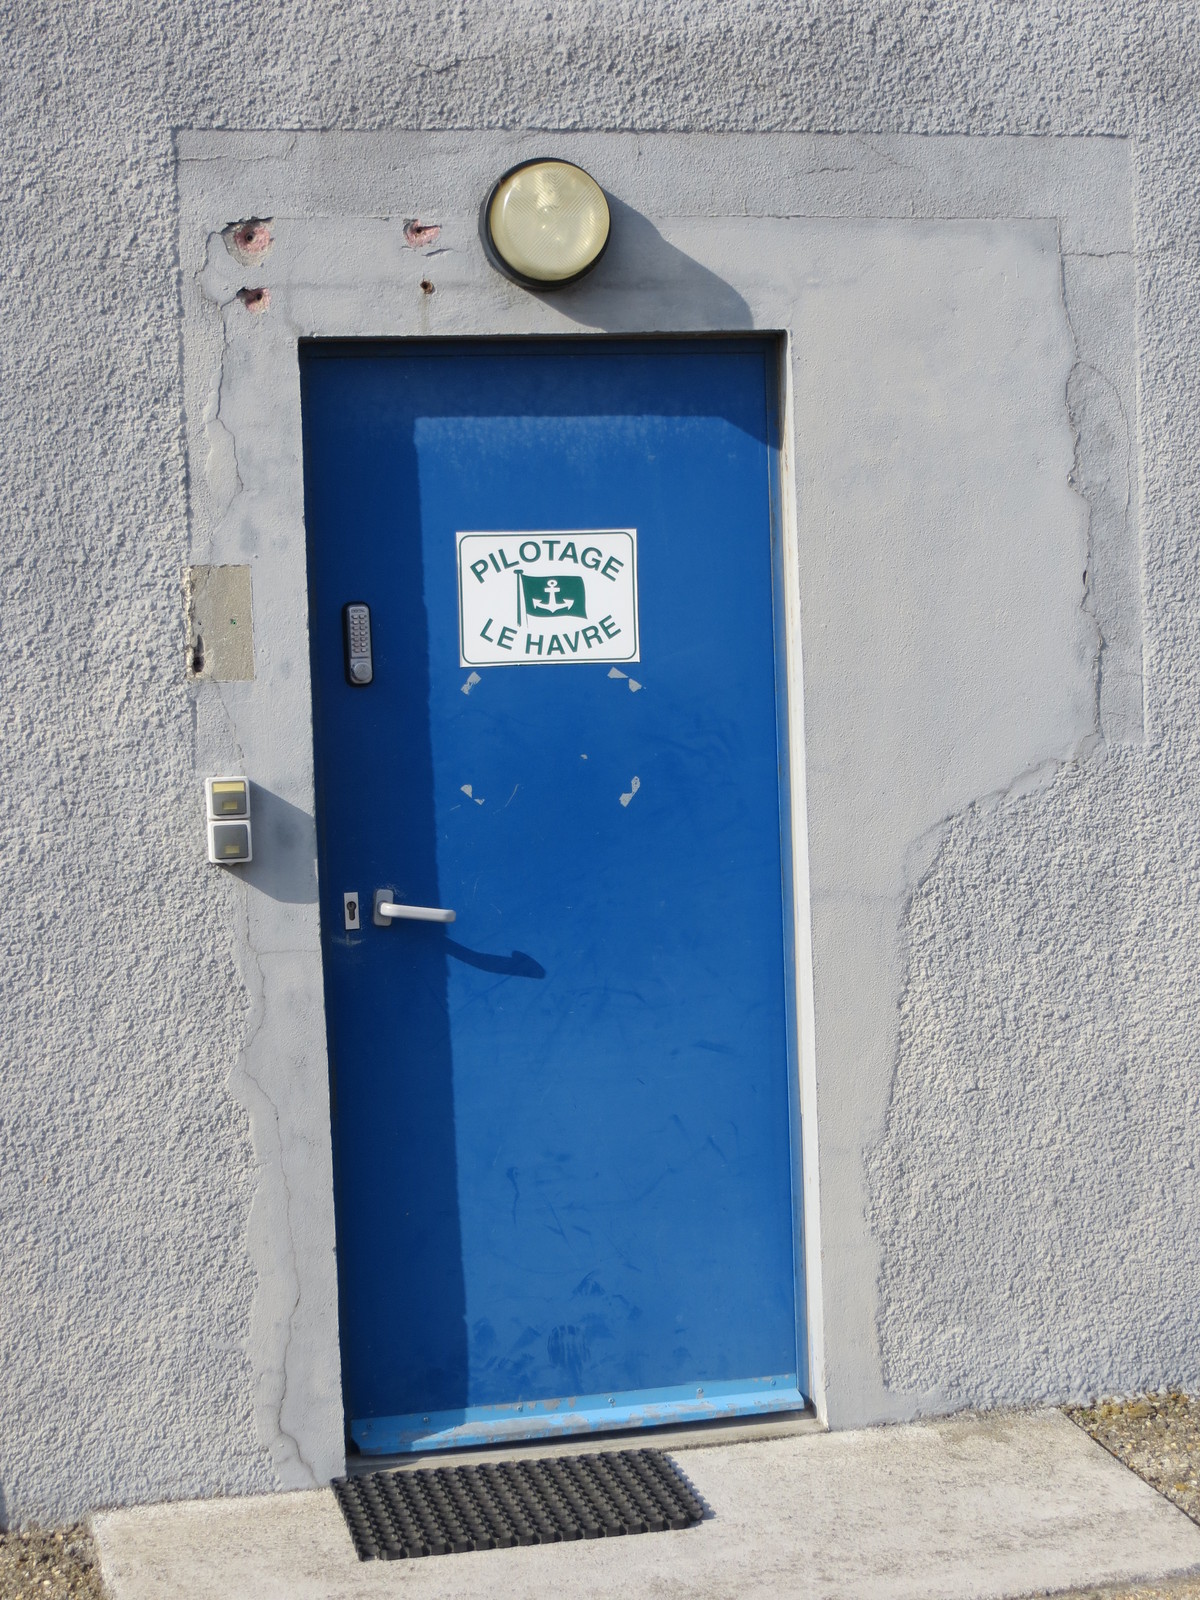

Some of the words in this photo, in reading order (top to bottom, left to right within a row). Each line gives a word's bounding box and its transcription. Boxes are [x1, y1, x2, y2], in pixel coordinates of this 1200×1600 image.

[470, 540, 624, 584] PILOTAGE
[479, 618, 517, 650] LE
[525, 614, 622, 655] HAVRE
